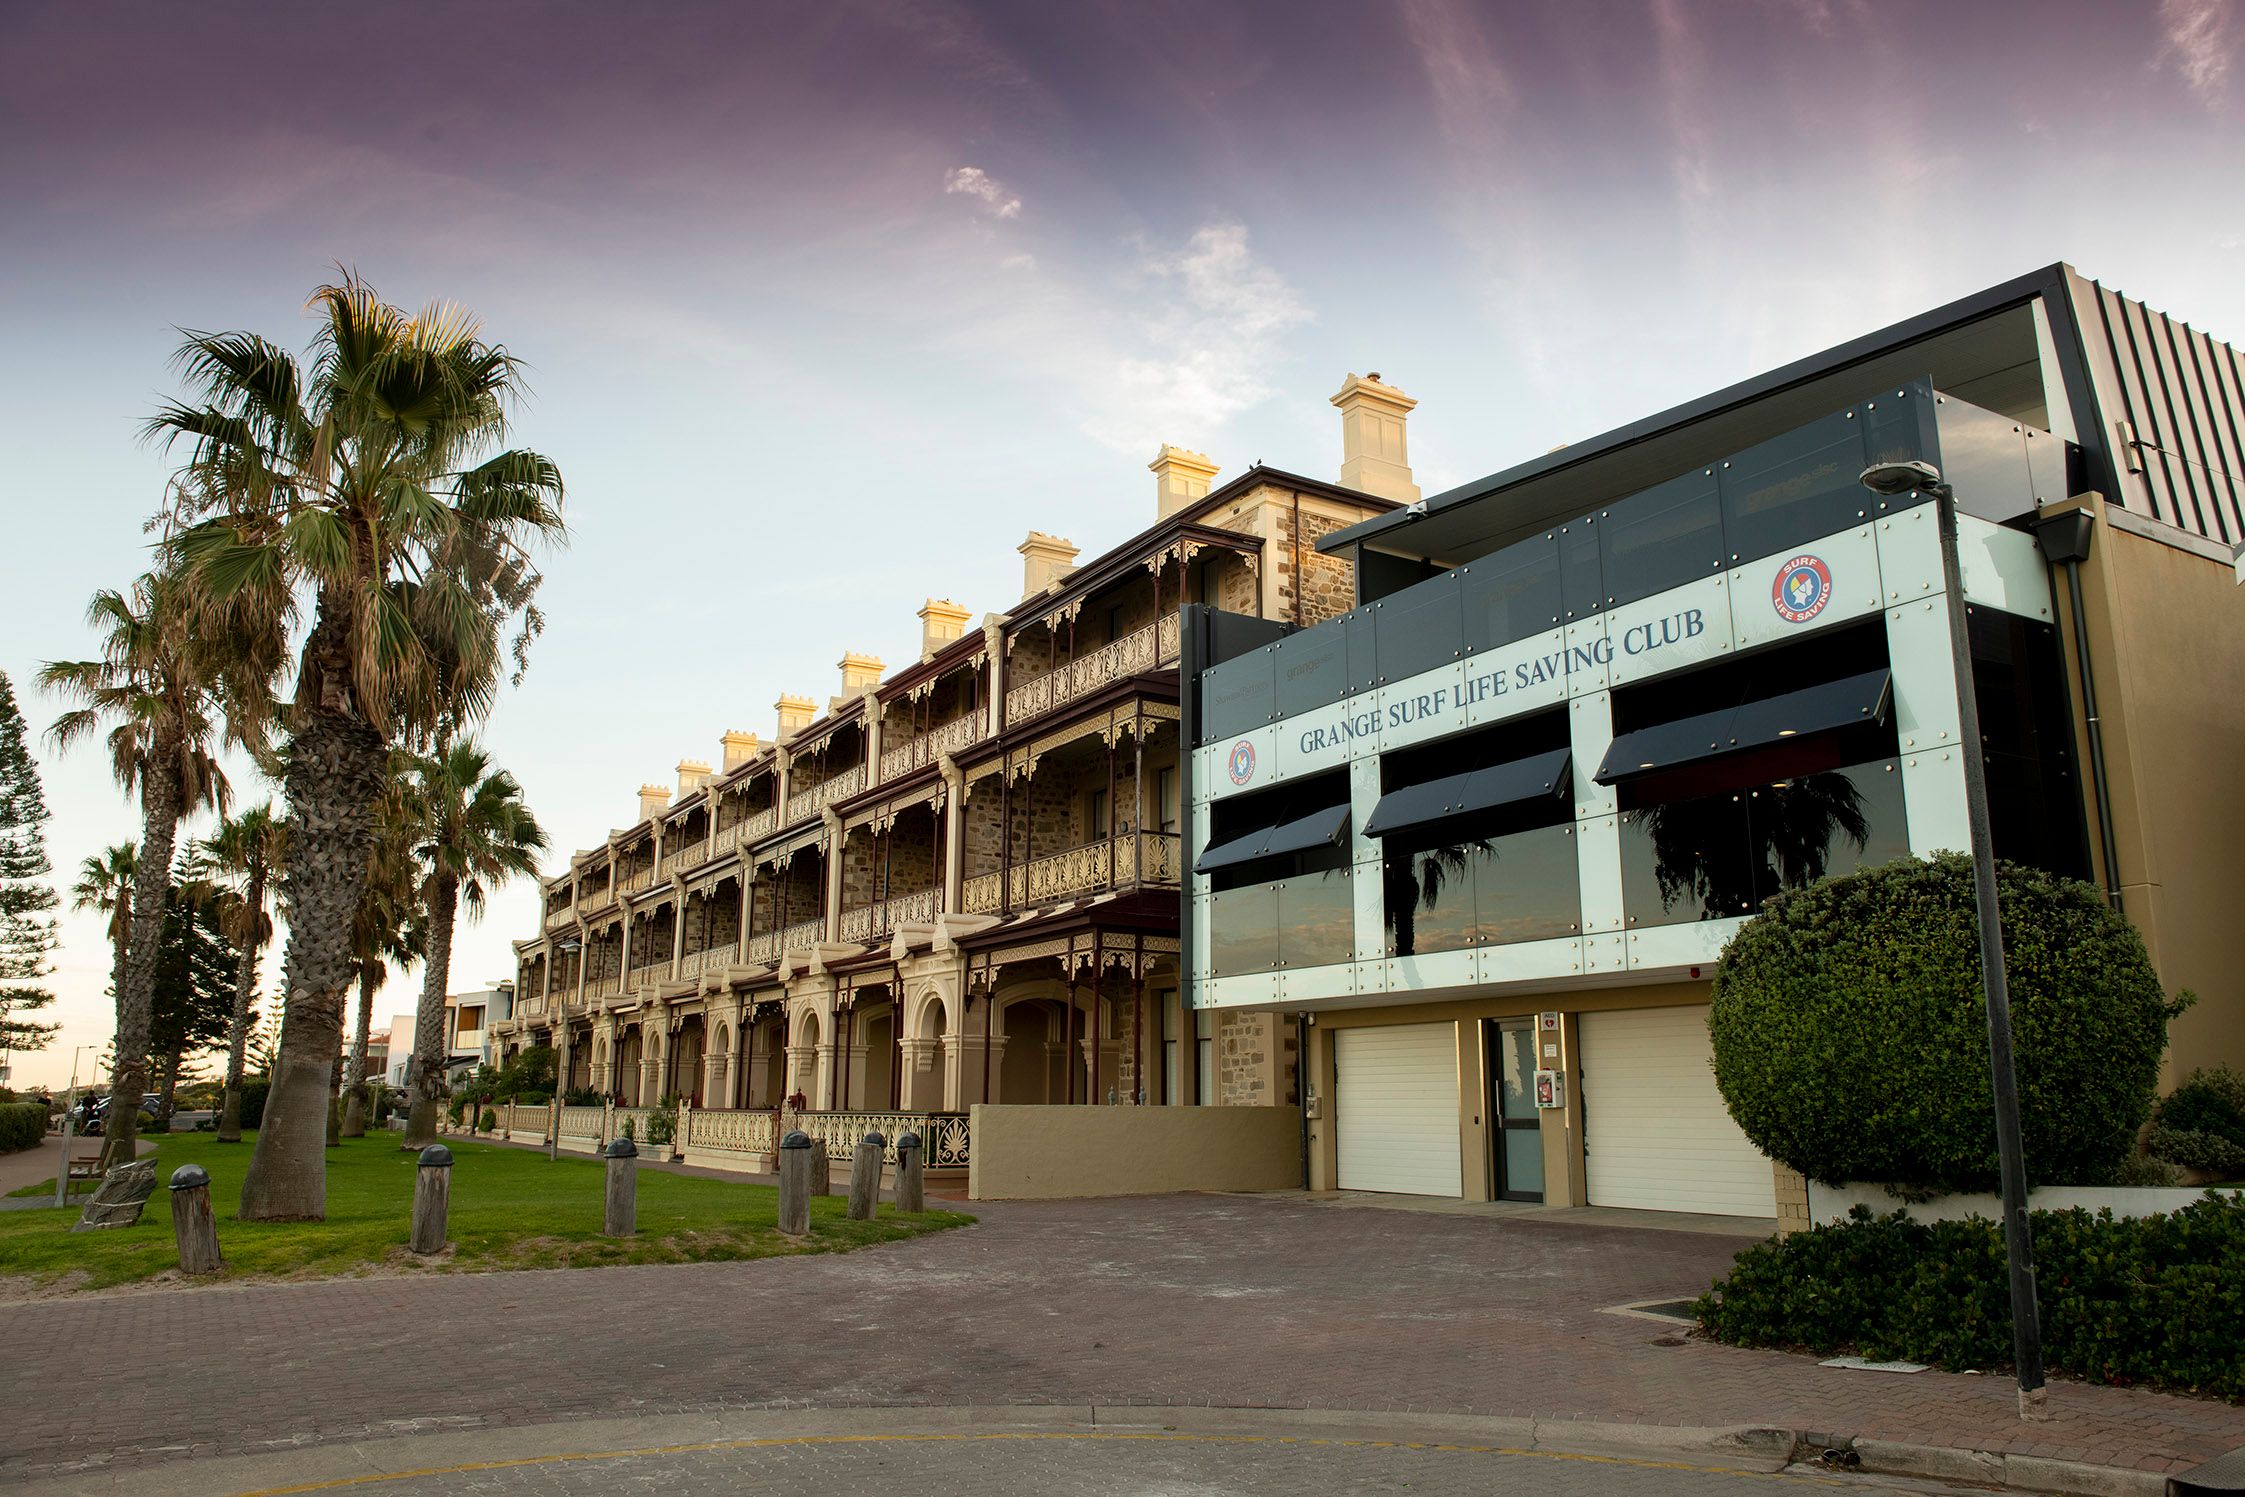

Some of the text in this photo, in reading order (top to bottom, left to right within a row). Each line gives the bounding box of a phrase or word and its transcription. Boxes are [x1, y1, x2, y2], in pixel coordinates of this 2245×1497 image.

[1783, 557, 1818, 574] SURF
[1774, 582, 1830, 621] LIFE SAVING
[1300, 608, 1704, 754] GRANGE SURF LIFE SAVING CLUB
